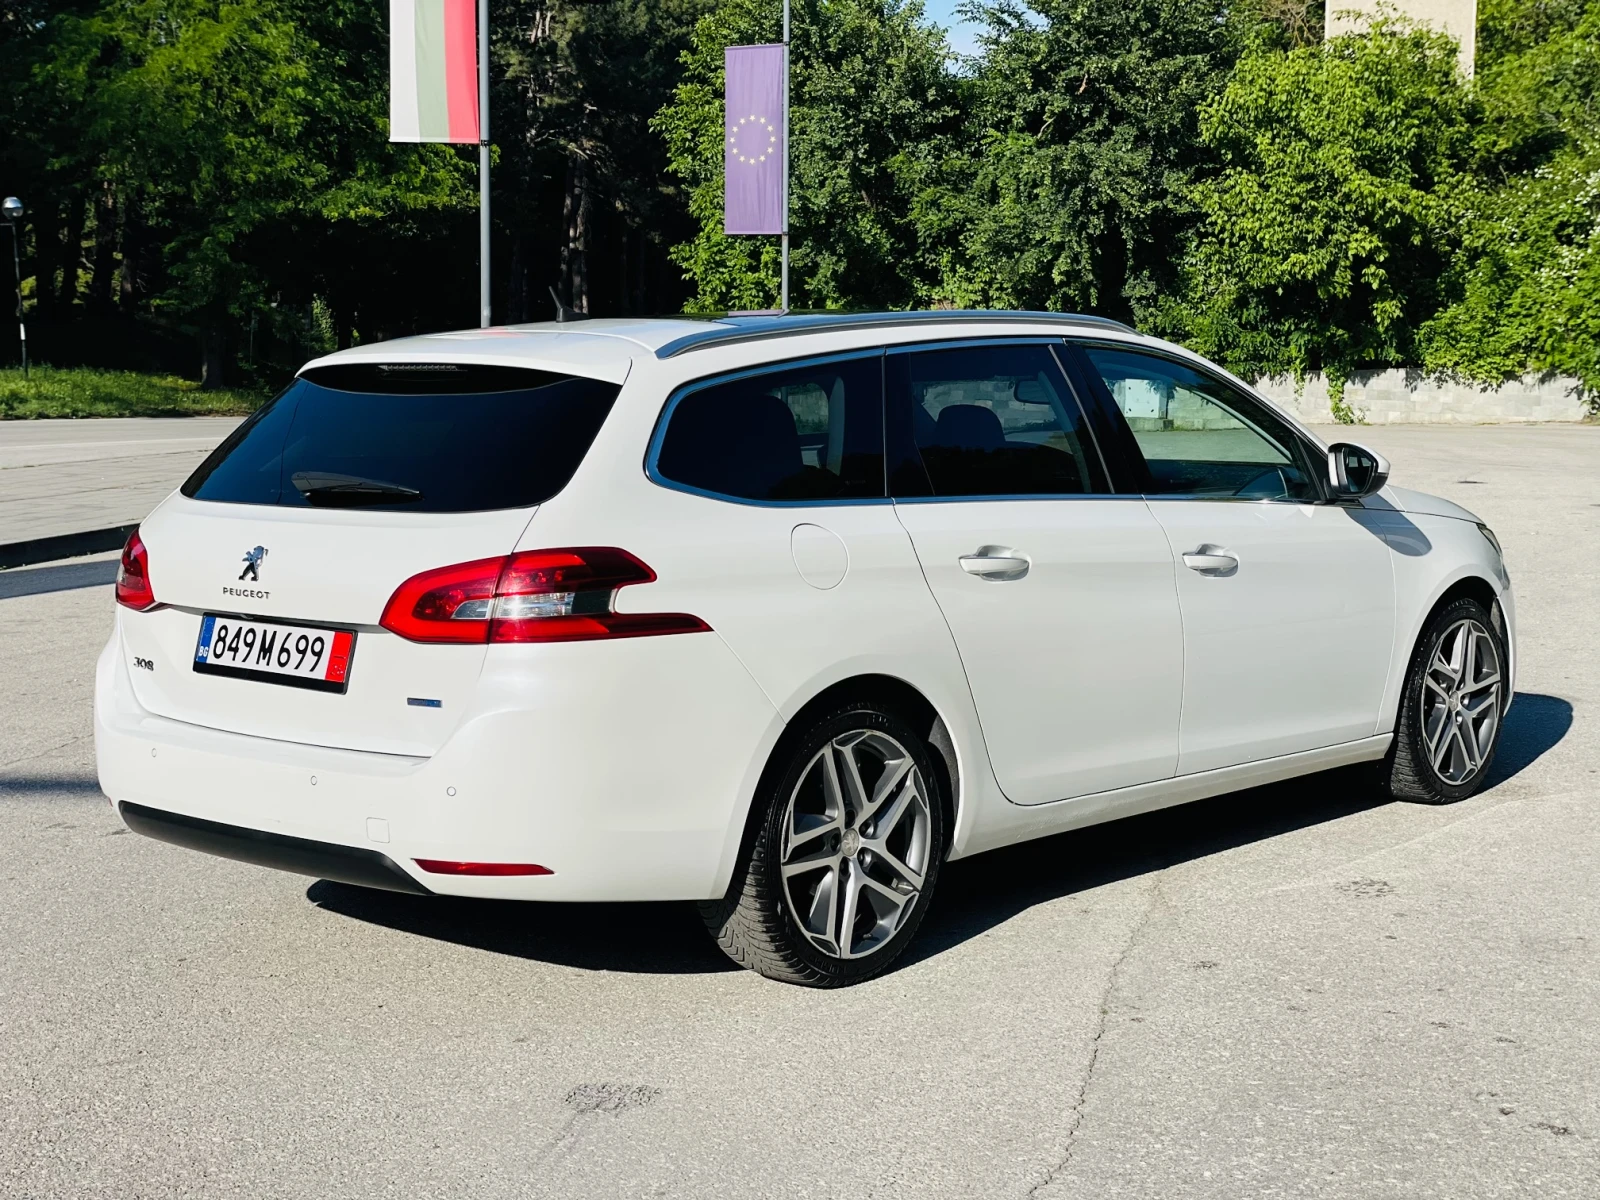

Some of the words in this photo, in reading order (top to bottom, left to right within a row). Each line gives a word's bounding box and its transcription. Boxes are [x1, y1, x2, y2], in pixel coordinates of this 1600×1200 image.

[222, 586, 270, 599] PEUGEOT
[198, 645, 209, 658] BG
[133, 656, 154, 672] 308
